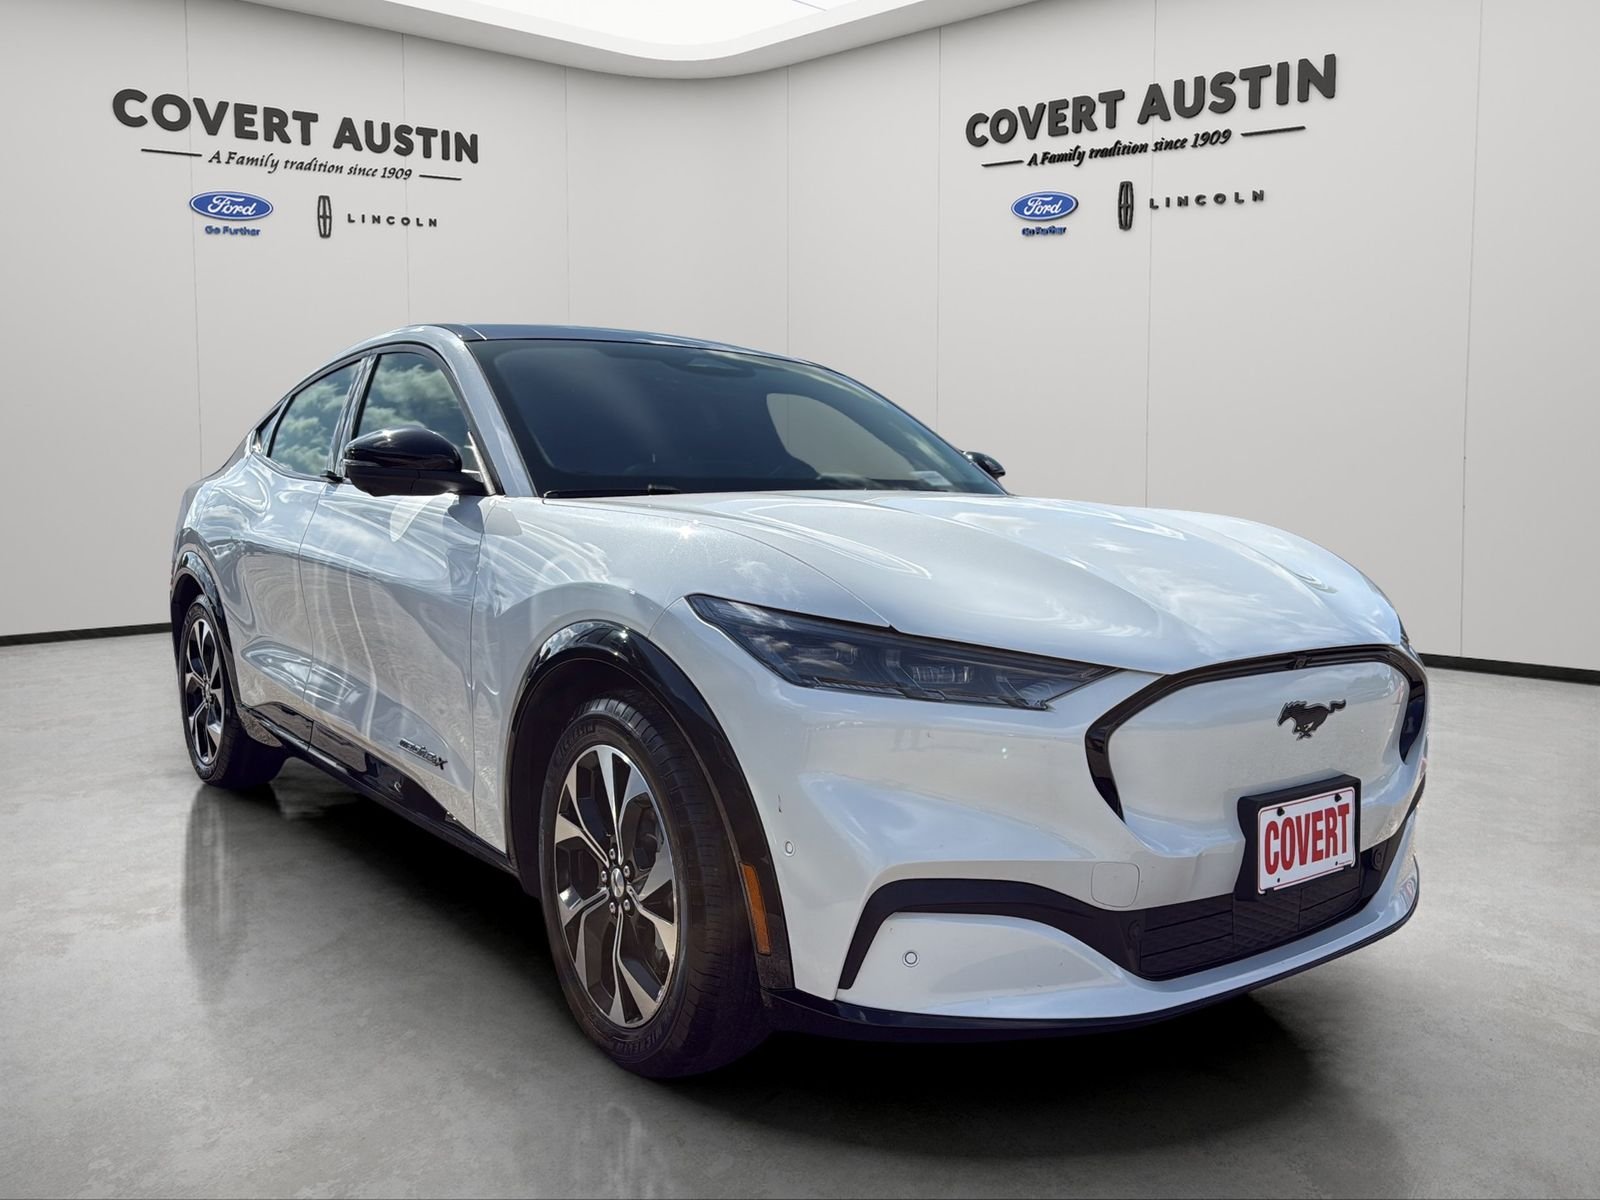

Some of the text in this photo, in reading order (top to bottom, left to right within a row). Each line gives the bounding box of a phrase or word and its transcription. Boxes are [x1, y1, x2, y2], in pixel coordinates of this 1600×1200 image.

[965, 53, 1337, 147] COVERT AUSTIN
[112, 88, 479, 164] COVERT AUSTIN
[1026, 127, 1232, 168] A Family tradition since 1909
[208, 150, 413, 181] A Family tradition since 1909
[207, 195, 257, 216] Ford
[1023, 196, 1063, 216] Ford
[1149, 189, 1265, 210] LINCOLN
[204, 225, 262, 237] Go Further
[347, 213, 438, 228] LINCOLN
[1264, 802, 1350, 875] COVERT
